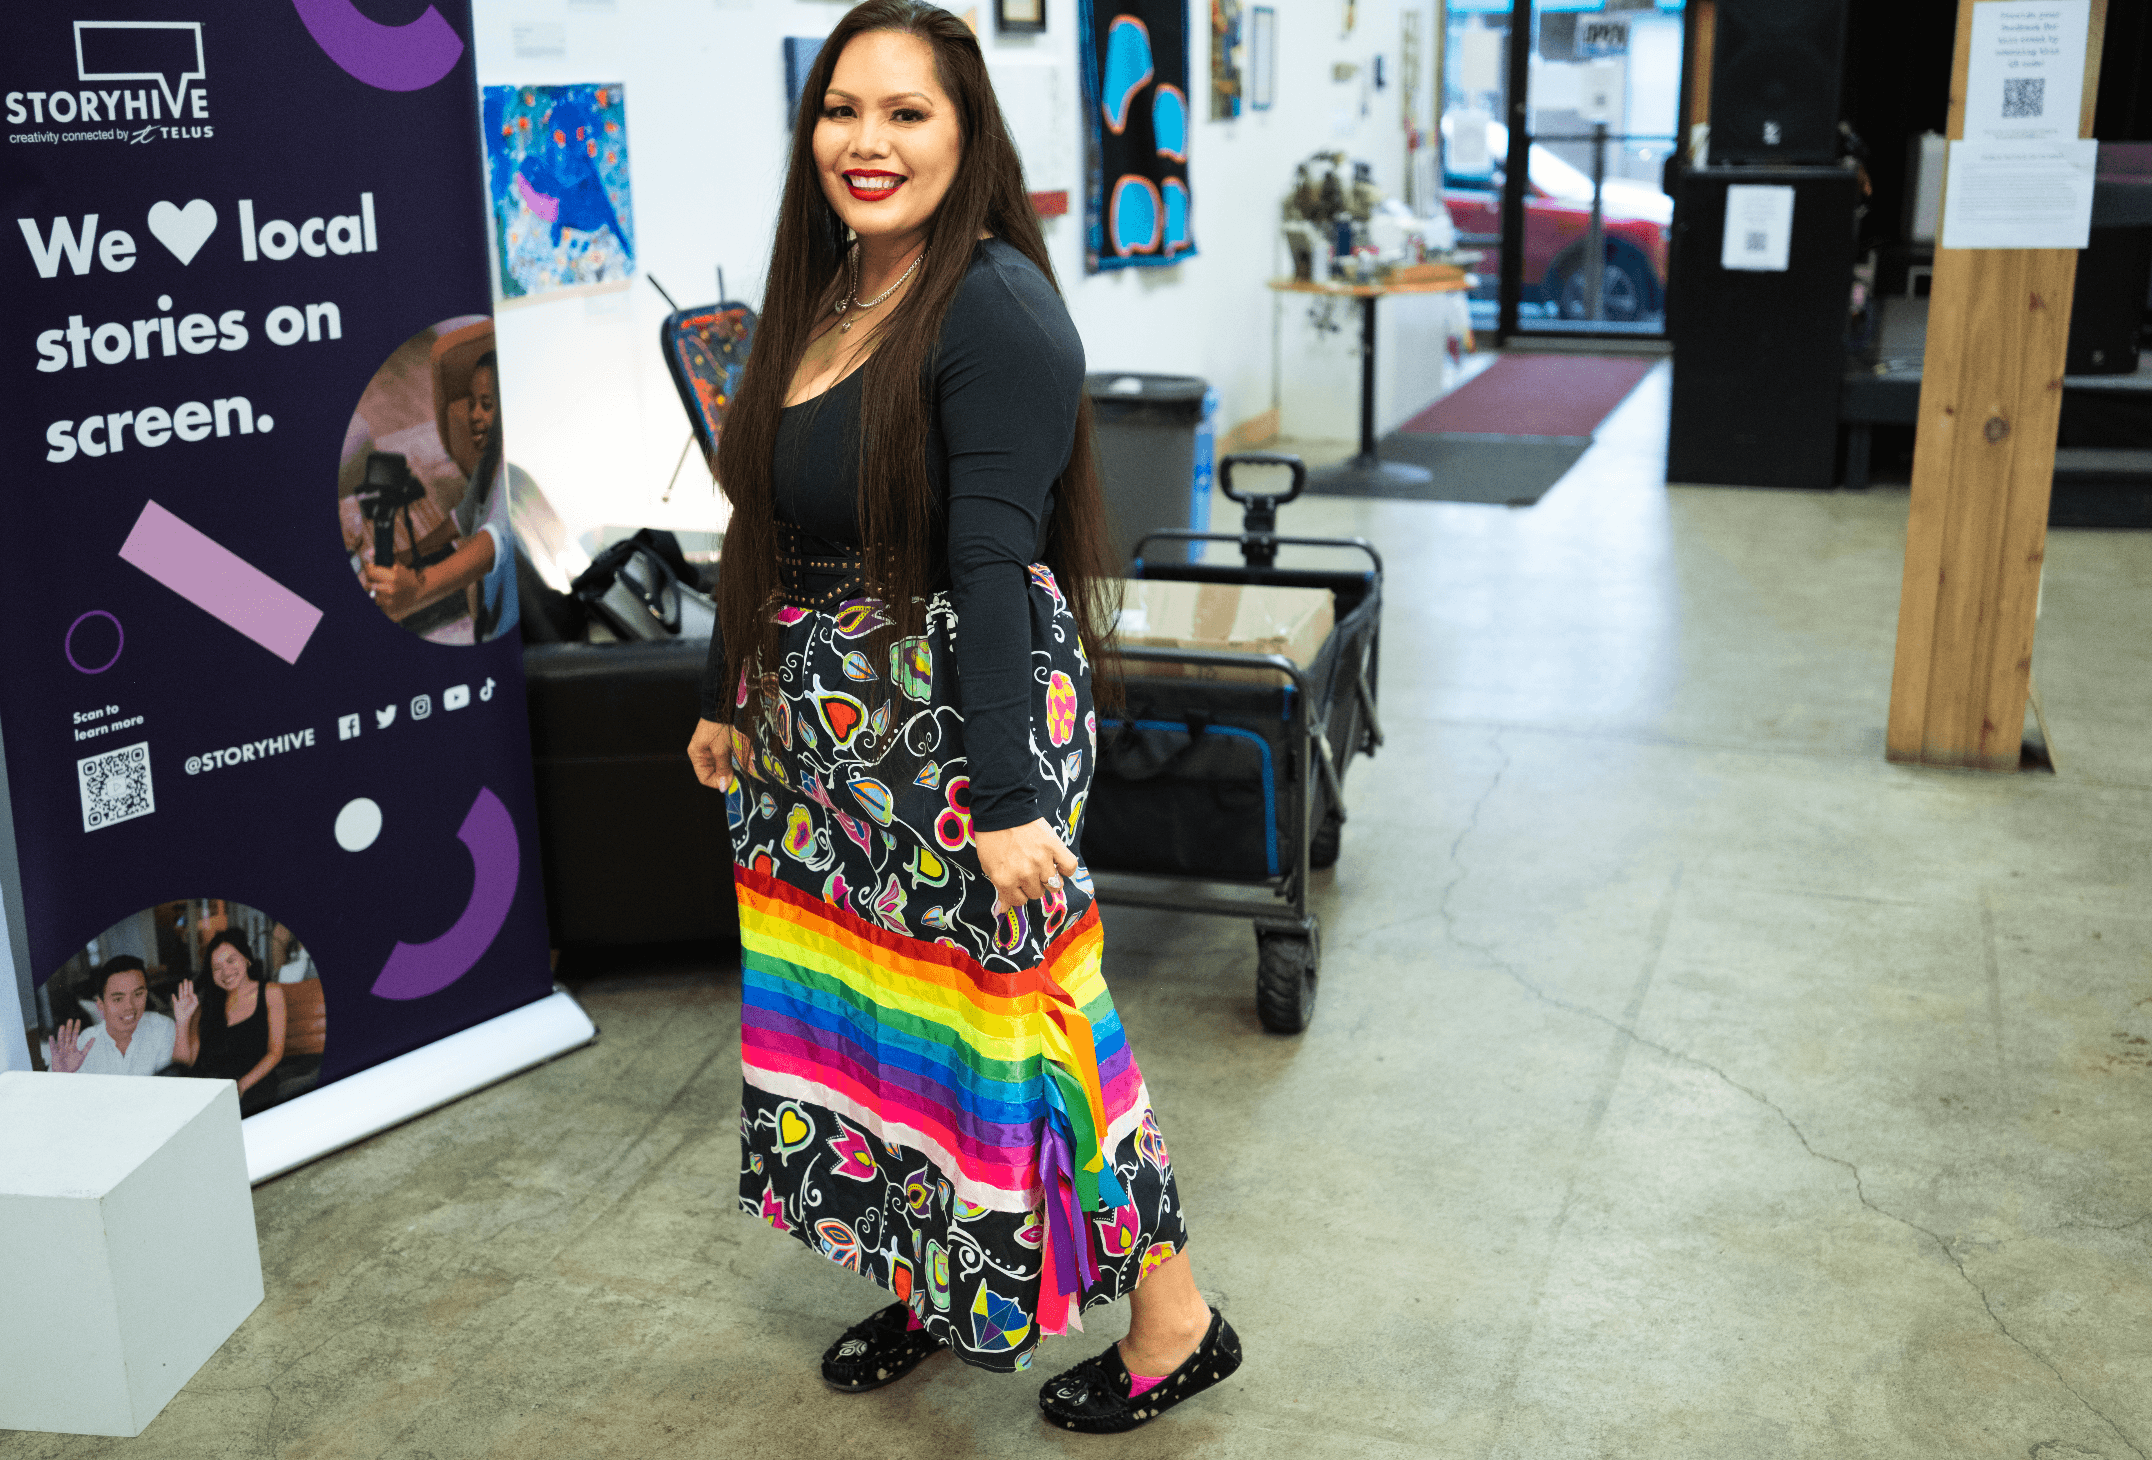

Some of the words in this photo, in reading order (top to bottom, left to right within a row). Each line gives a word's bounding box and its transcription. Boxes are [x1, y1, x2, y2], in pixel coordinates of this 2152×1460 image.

[6, 88, 209, 124] STORYHIVE
[10, 131, 59, 144] creativity
[62, 129, 114, 141] connected
[117, 129, 128, 141] by
[161, 126, 213, 138] TELUS
[17, 214, 136, 278] We
[238, 192, 378, 261] local
[36, 295, 249, 372] stories
[265, 302, 342, 346] on
[46, 396, 274, 463] screen.
[73, 709, 103, 724] Scan
[106, 705, 119, 715] to
[75, 725, 108, 741] learn
[111, 716, 143, 731] more
[185, 728, 314, 775] @STORYHIVE
